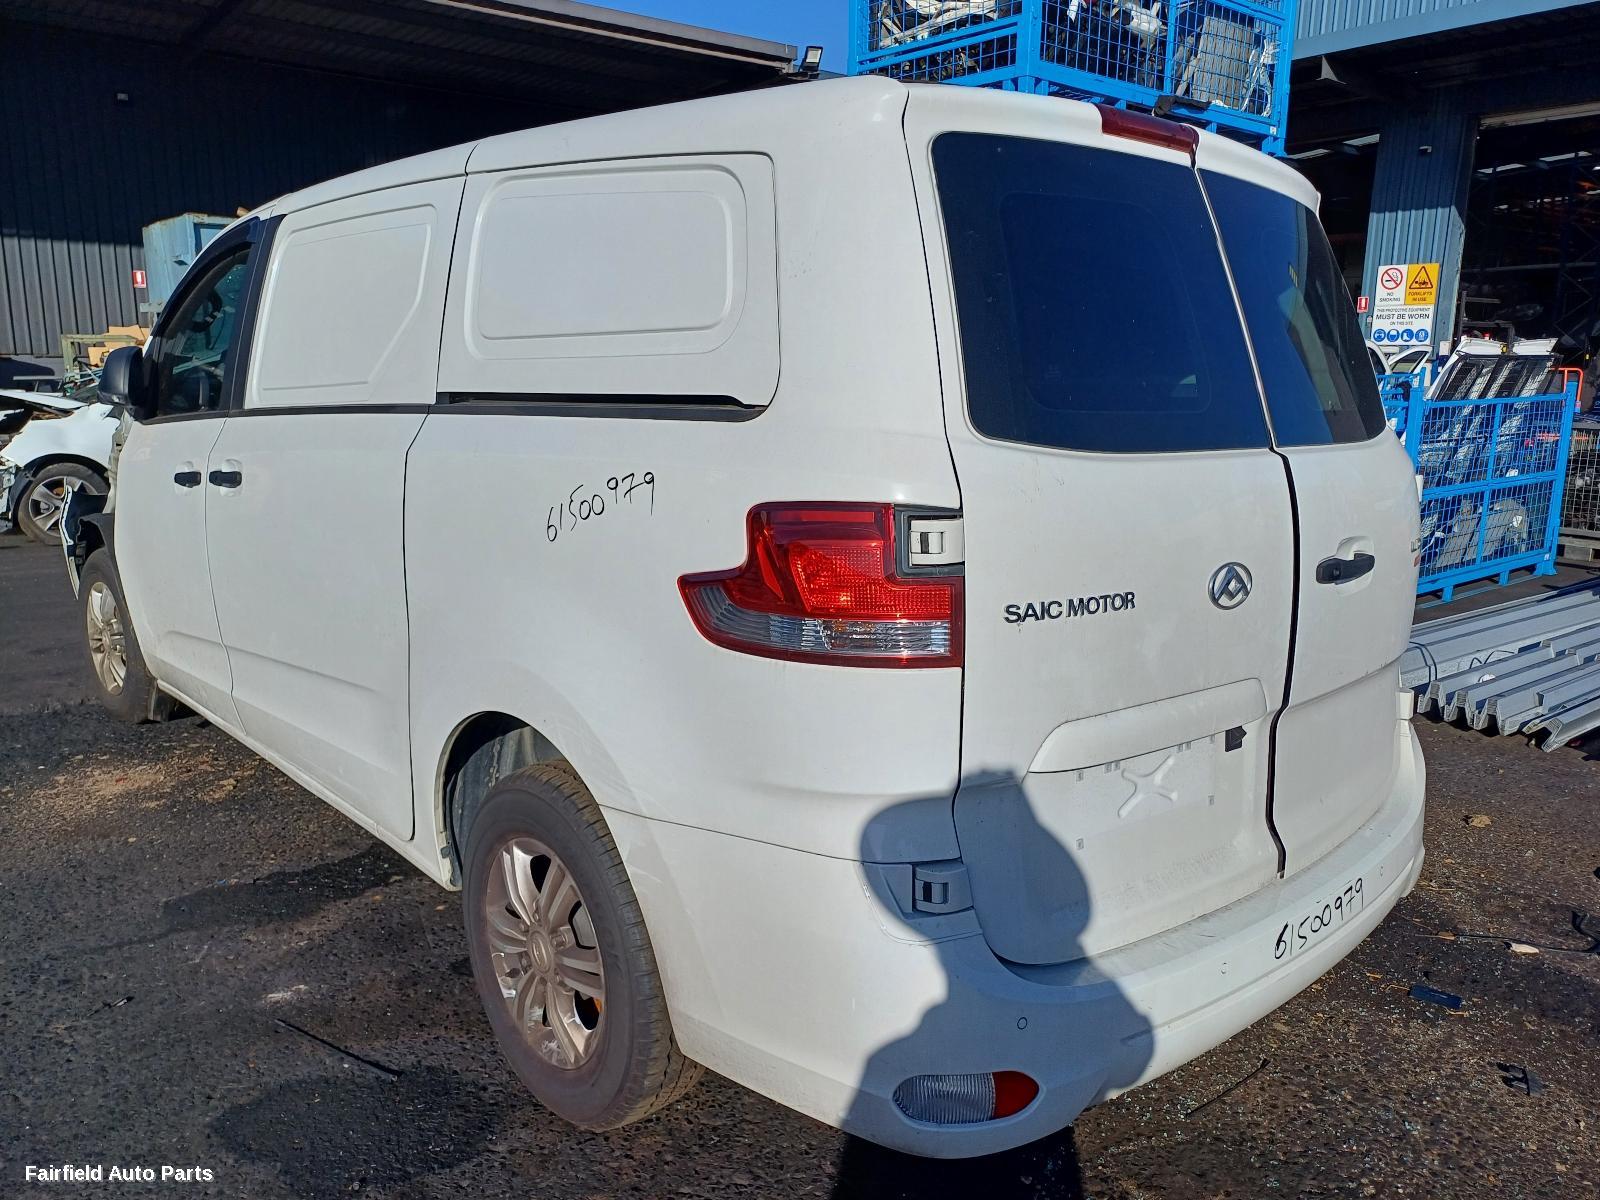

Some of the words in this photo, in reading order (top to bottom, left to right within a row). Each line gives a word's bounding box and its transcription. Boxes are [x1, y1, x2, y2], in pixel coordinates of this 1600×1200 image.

[546, 471, 655, 542] 61500979
[1003, 600, 1063, 623] SAIC
[1066, 591, 1136, 618] MOTOR
[1274, 877, 1364, 960] 61500979
